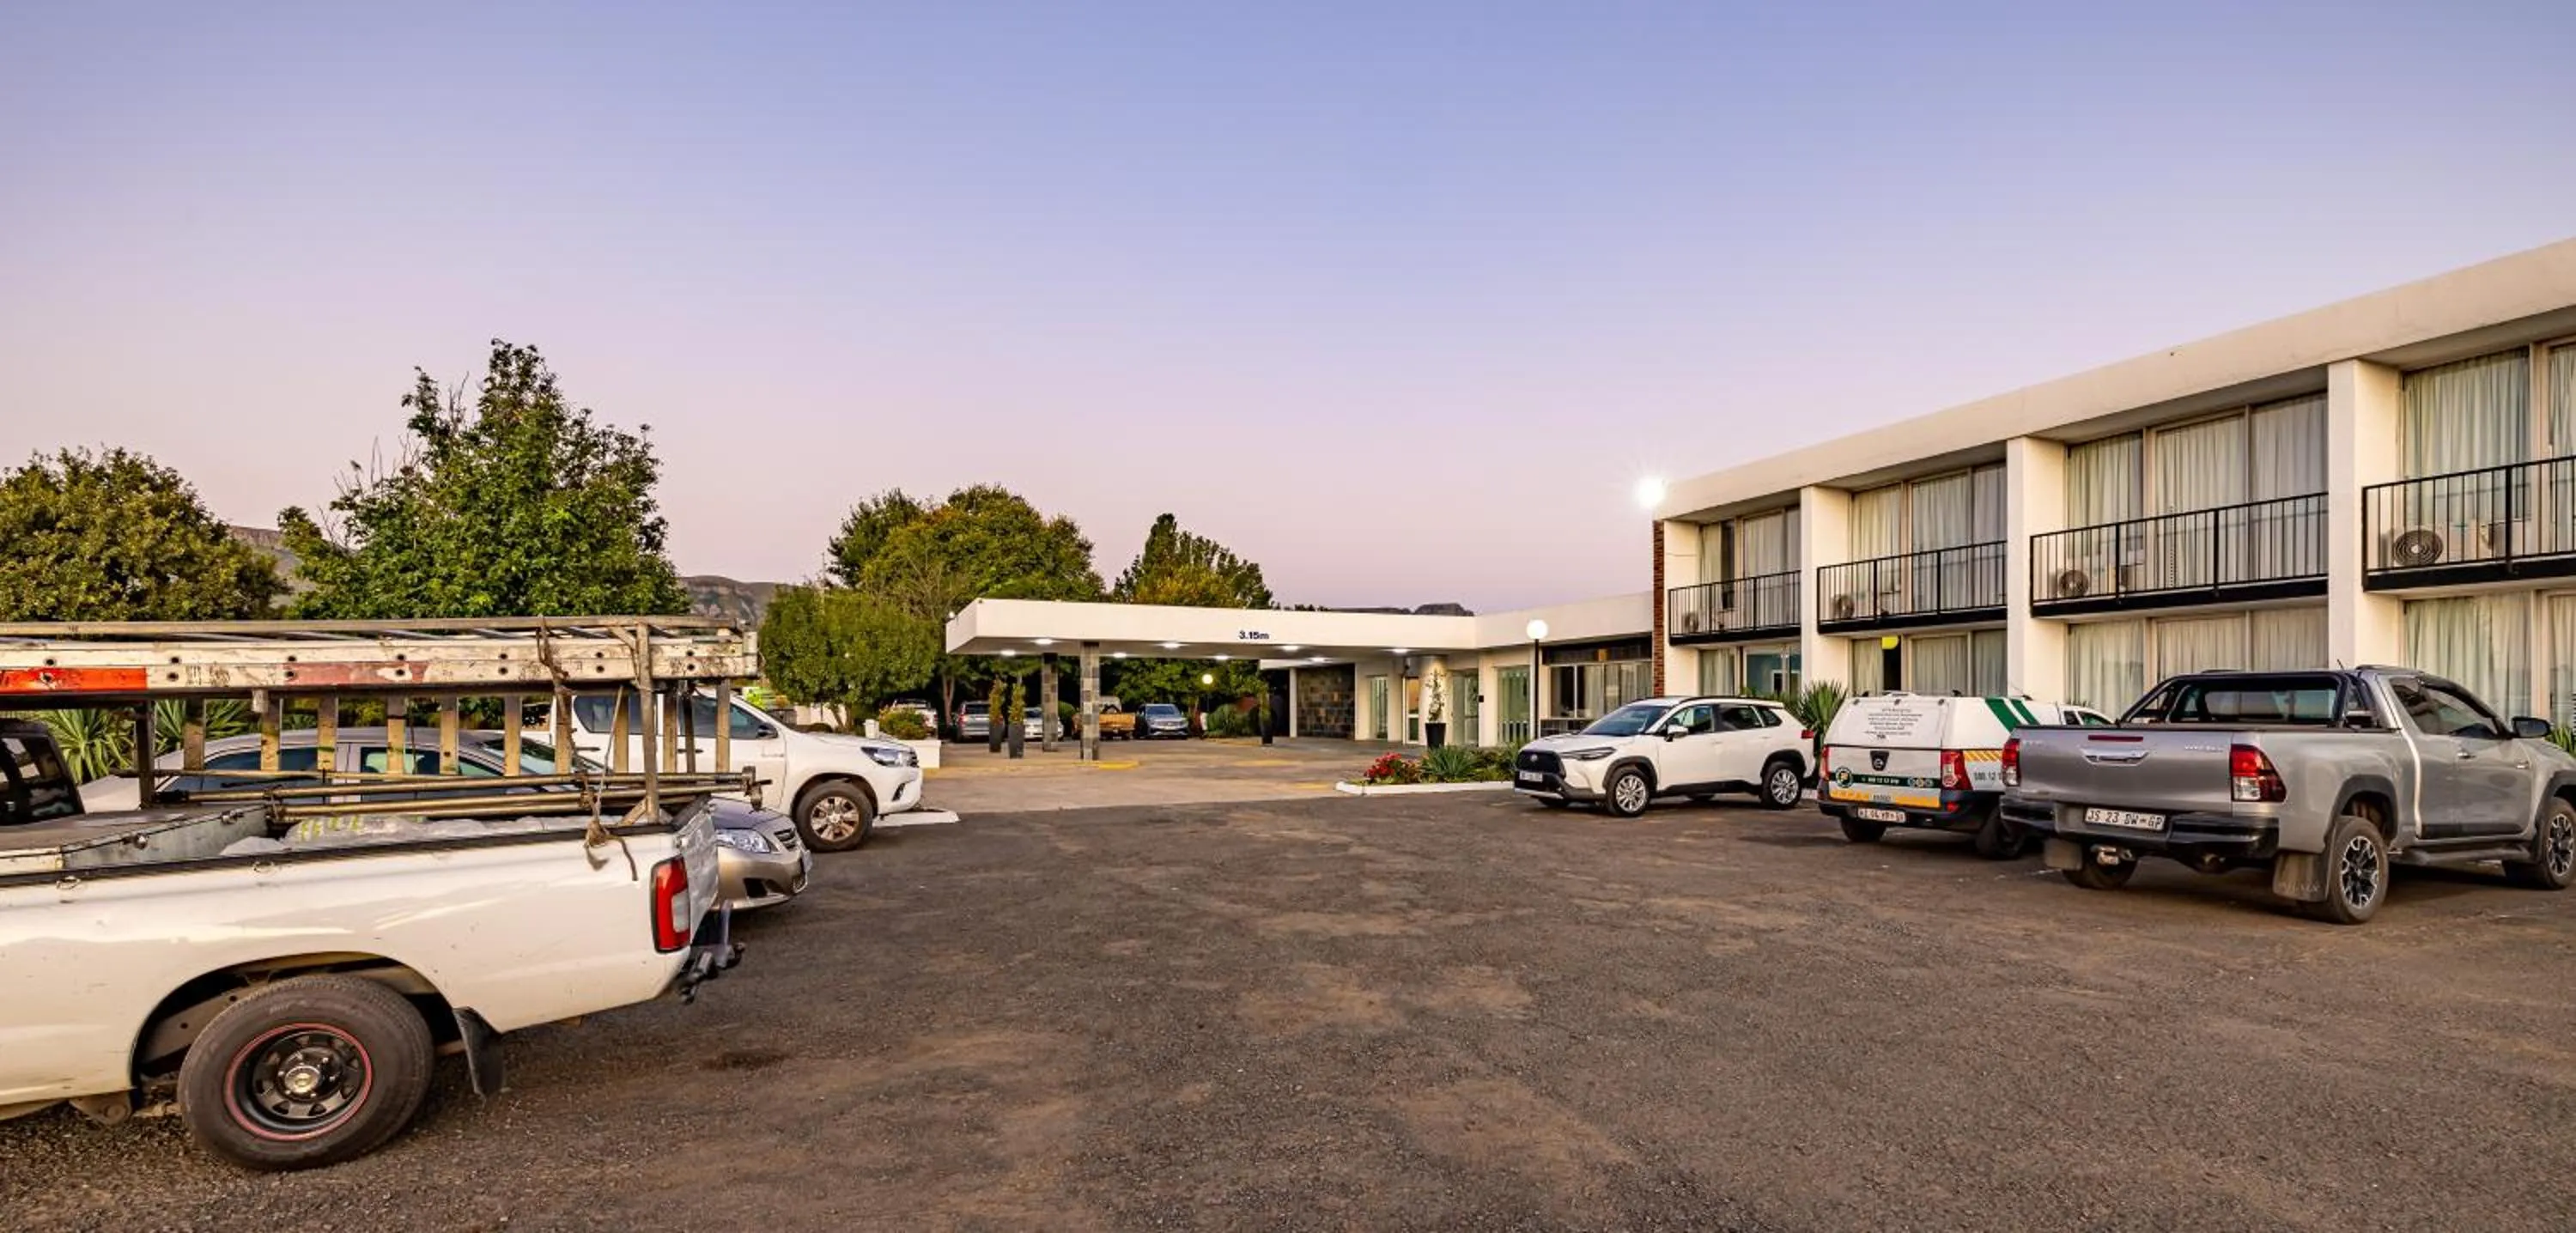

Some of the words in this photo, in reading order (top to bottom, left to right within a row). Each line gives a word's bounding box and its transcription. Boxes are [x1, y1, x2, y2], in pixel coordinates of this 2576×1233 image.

[1239, 630, 1269, 640] 3.15m
[2088, 810, 2100, 822] JS
[2105, 811, 2120, 823] 23
